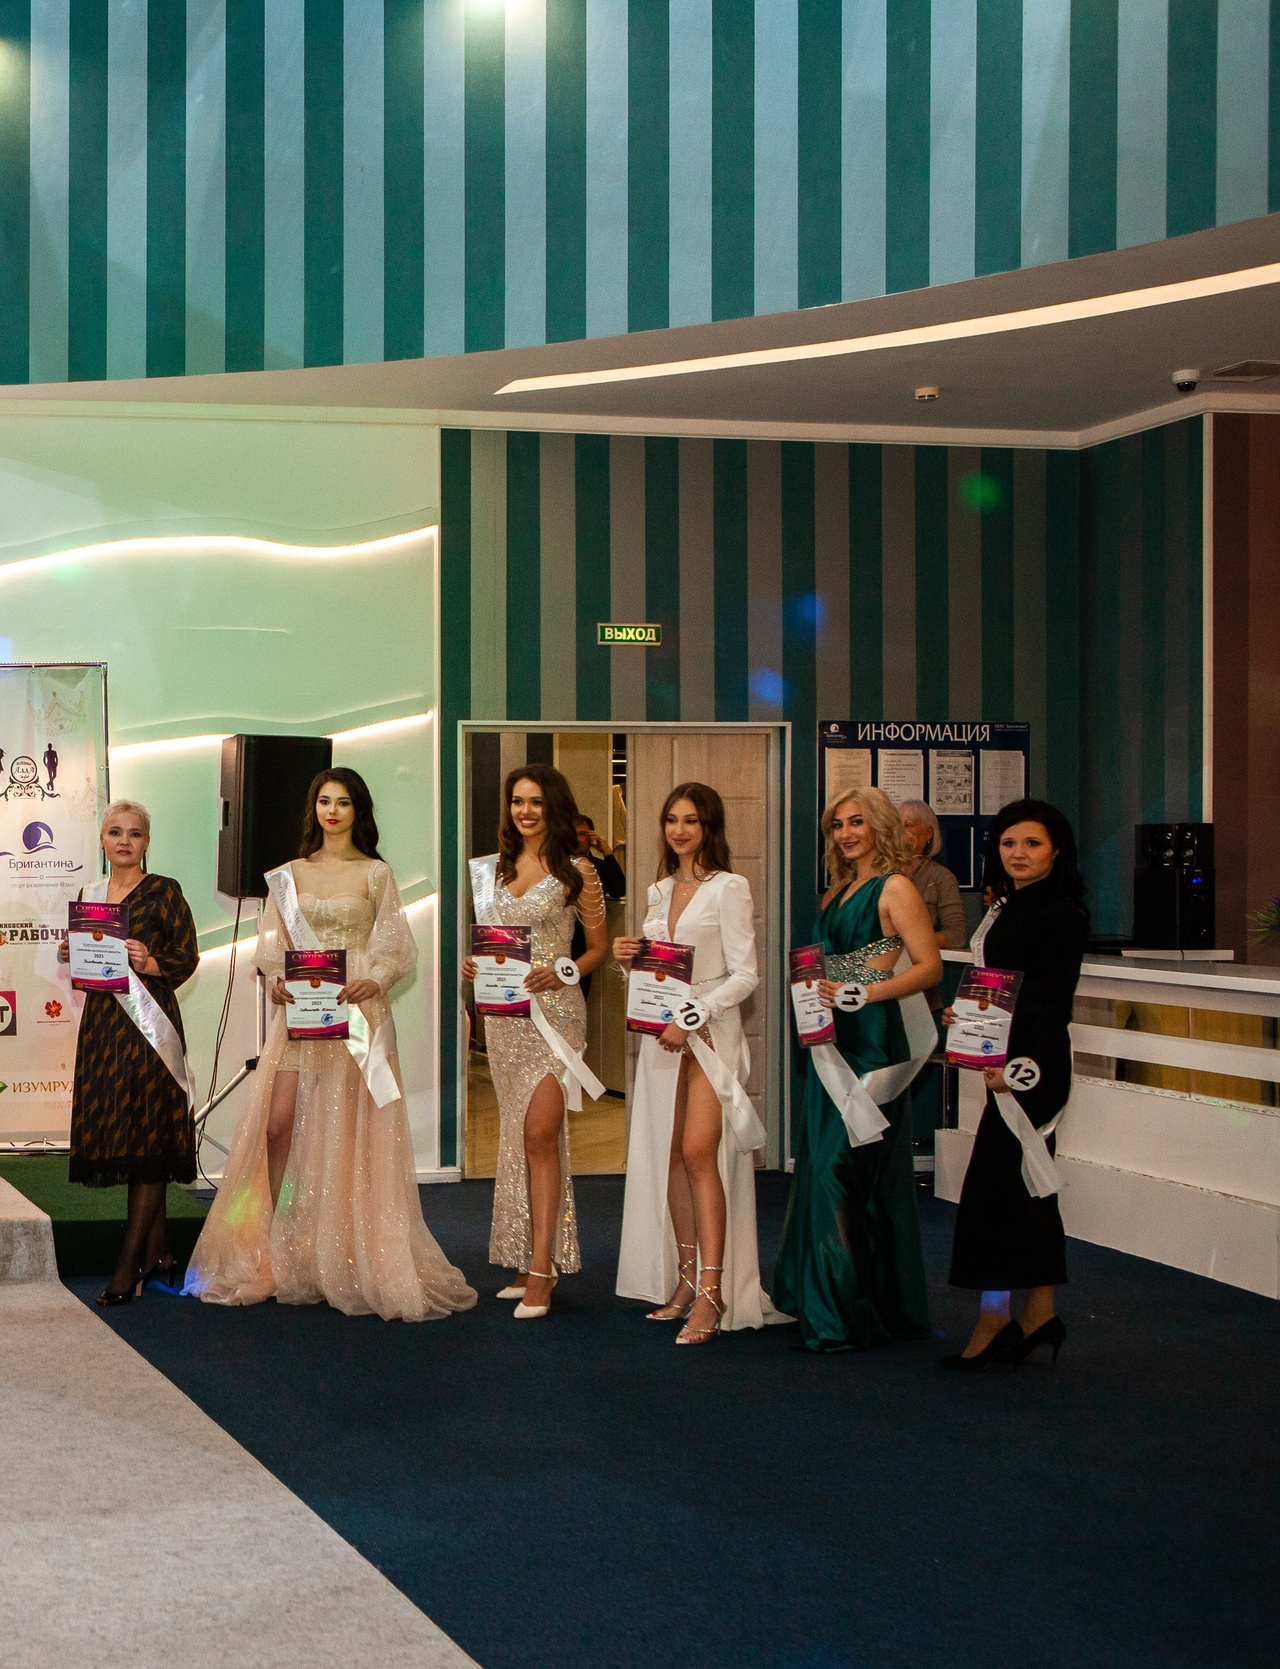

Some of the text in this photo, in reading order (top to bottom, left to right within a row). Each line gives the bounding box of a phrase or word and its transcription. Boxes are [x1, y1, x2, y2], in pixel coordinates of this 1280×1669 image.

[604, 628, 656, 641] ВЫХОД
[858, 722, 990, 745] ИНФОРМАЦИЯ
[8, 858, 74, 871] Бригантина
[9, 928, 69, 941] РАБОЧИ
[841, 987, 861, 1006] 11
[680, 1002, 700, 1026] 10
[1008, 1062, 1036, 1087] 12
[12, 1080, 74, 1093] ИЗУМРУ
